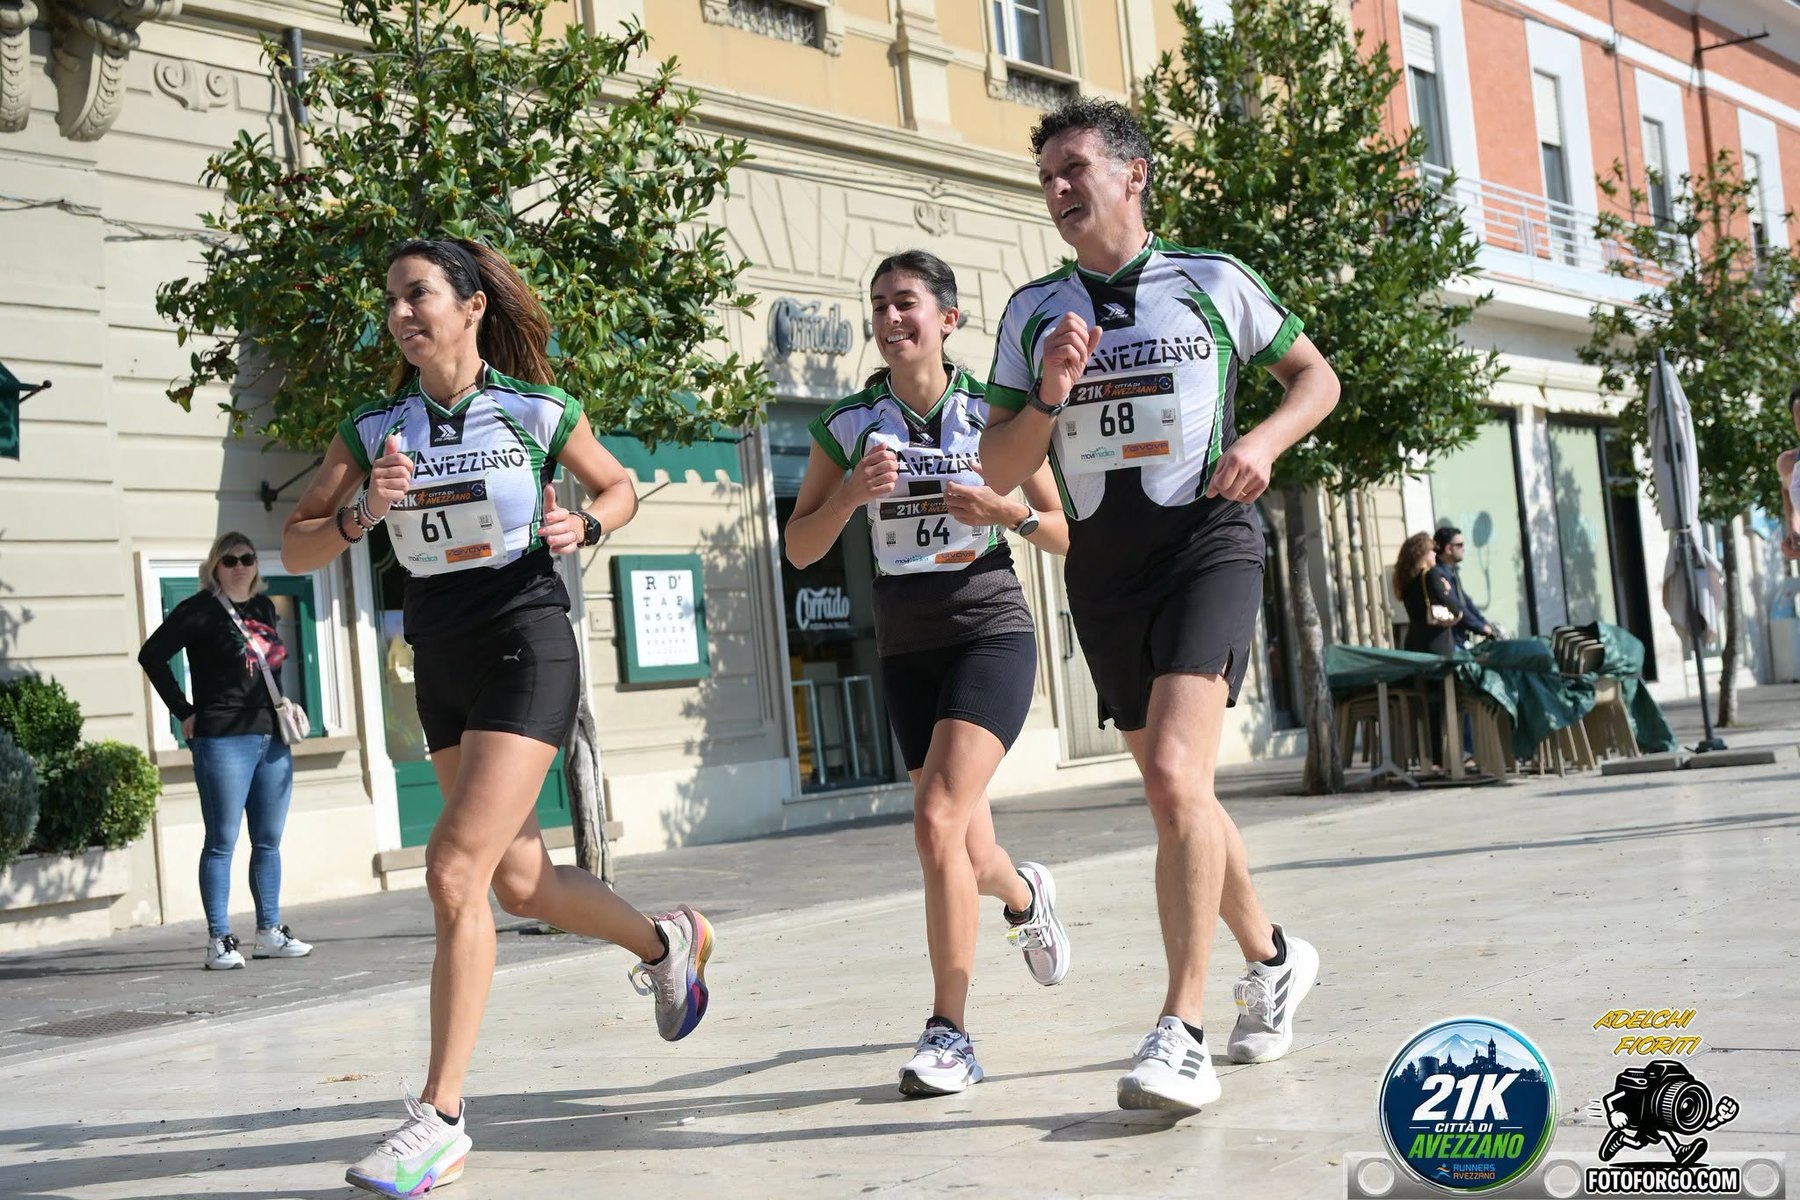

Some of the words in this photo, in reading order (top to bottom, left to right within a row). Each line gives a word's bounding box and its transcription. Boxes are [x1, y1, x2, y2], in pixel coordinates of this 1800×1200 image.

[1083, 335, 1211, 375] AVEZZANO
[1077, 385, 1104, 401] 21K
[1100, 402, 1135, 437] 68
[414, 448, 524, 479] AVEZZANO
[896, 503, 920, 516] 21K
[421, 510, 453, 543] 61
[916, 517, 950, 547] 64
